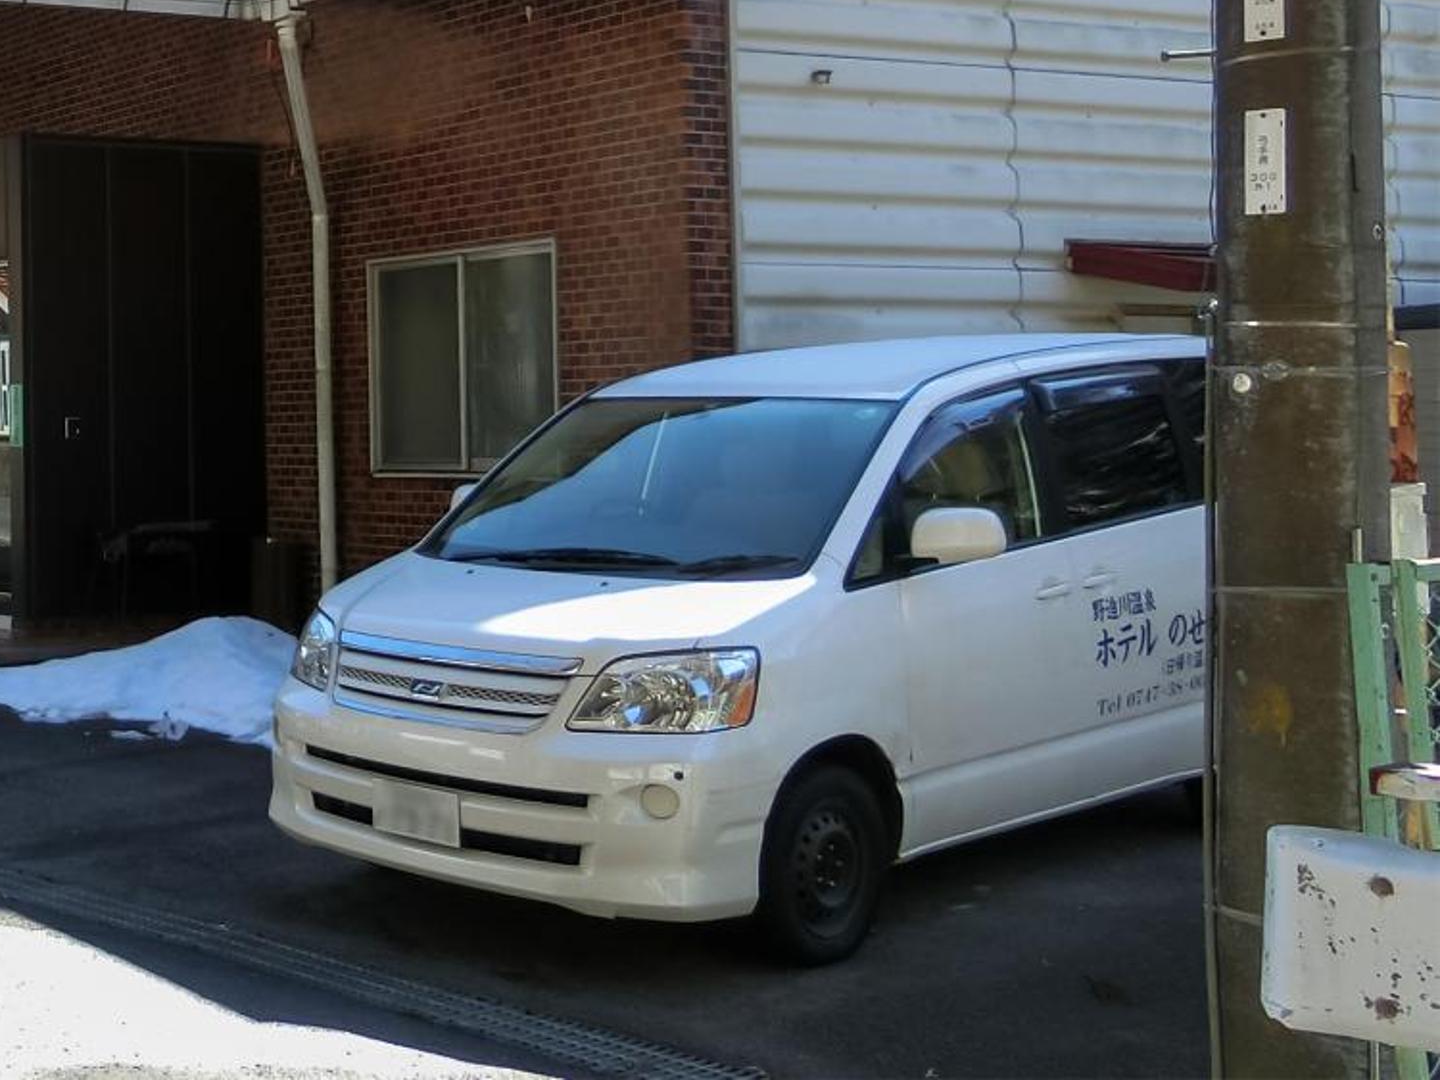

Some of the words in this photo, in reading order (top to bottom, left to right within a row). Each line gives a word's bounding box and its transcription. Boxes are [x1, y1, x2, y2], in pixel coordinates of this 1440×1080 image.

[1095, 617, 1157, 668] ホテル
[1168, 608, 1205, 647] のせ
[1096, 694, 1122, 717] Tel
